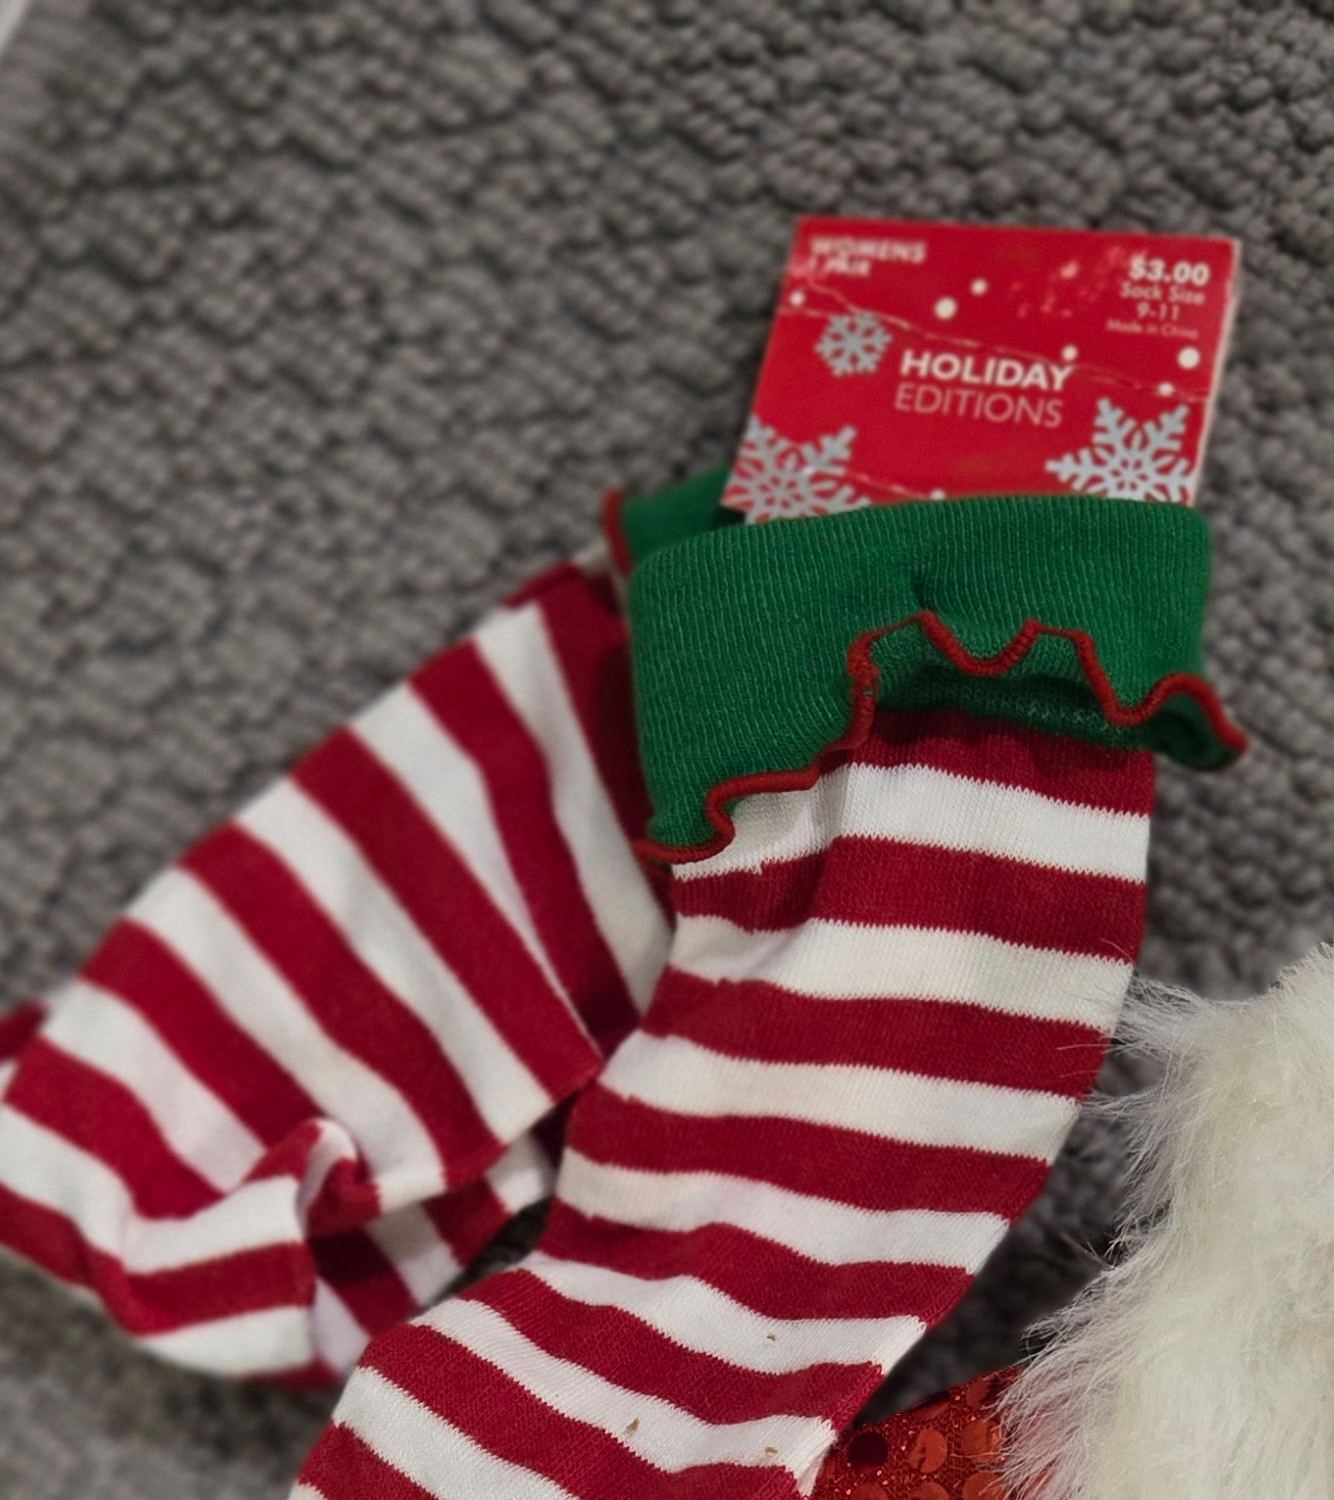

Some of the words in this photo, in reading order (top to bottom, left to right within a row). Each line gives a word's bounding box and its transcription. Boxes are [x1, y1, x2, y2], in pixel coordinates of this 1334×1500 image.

[1128, 253, 1209, 286] $3.00
[1120, 280, 1161, 299] Sock
[1168, 284, 1205, 304] Size
[1136, 301, 1180, 320] 9-11
[1106, 319, 1142, 332] Made
[1161, 324, 1199, 339] China
[899, 349, 1073, 391] HOLIDAY
[894, 383, 1064, 428] EDITIONS
